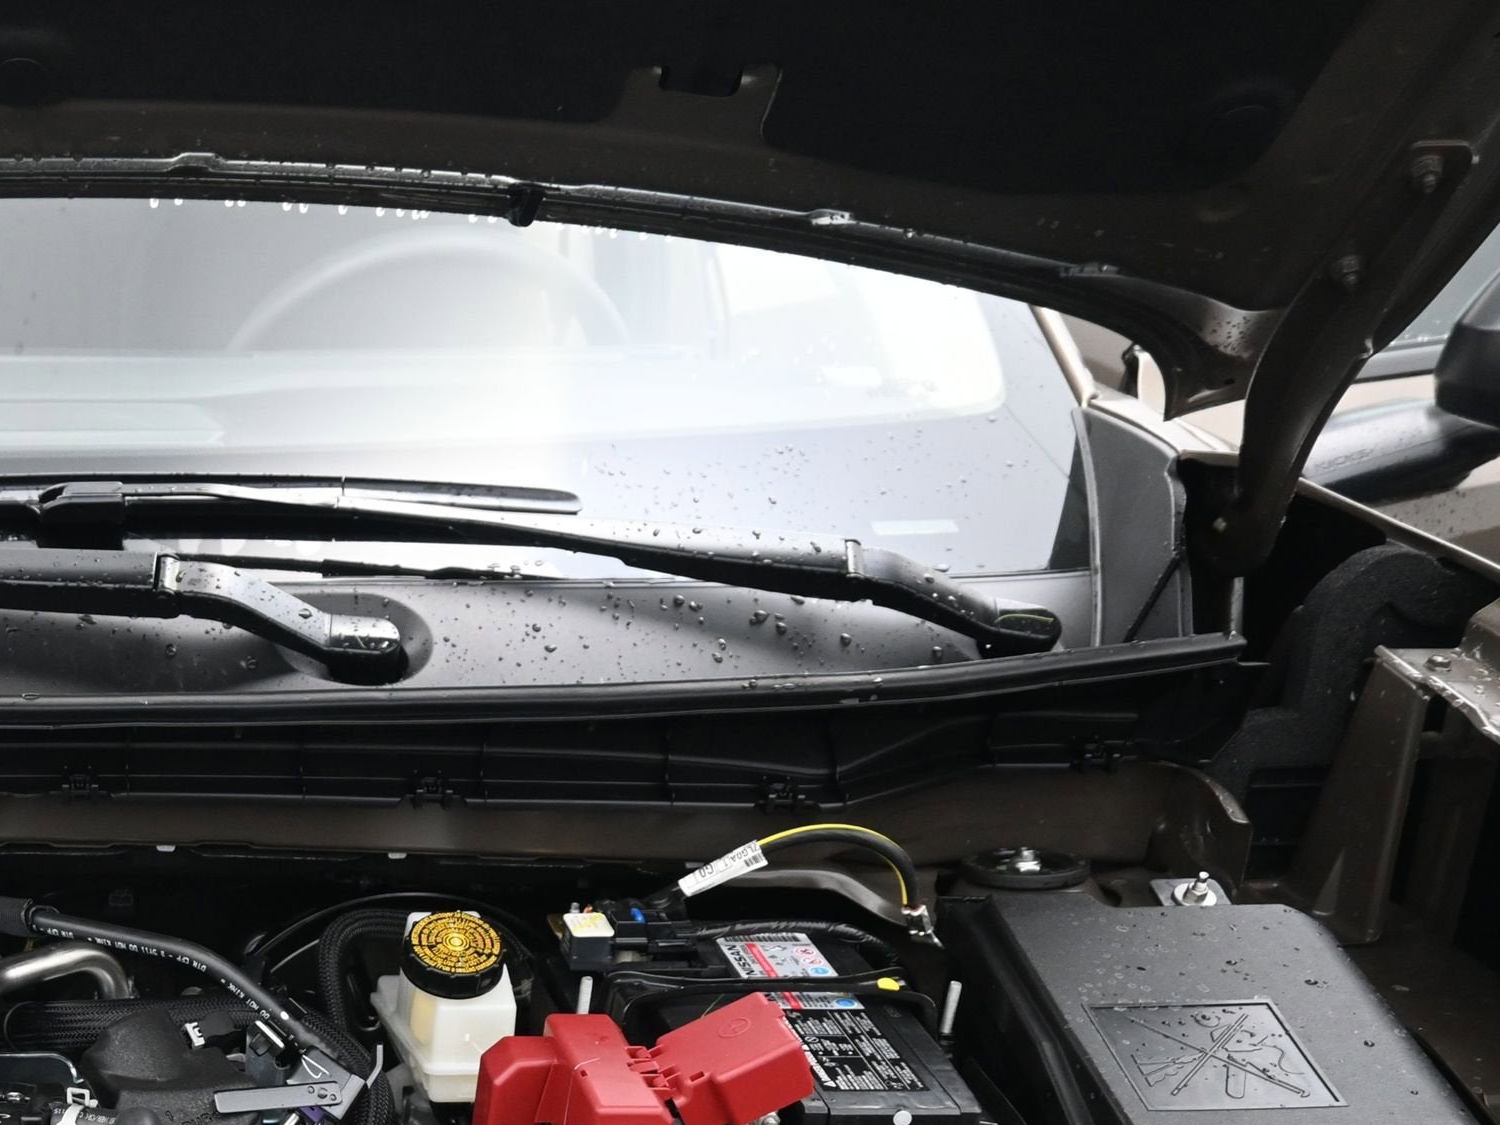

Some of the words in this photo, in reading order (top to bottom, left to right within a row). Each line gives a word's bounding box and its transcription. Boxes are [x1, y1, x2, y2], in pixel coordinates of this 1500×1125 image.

[725, 943, 758, 977] NISSAN
[227, 981, 246, 999] KINK
[246, 997, 260, 1010] NOT
[260, 1008, 271, 1021] DO
